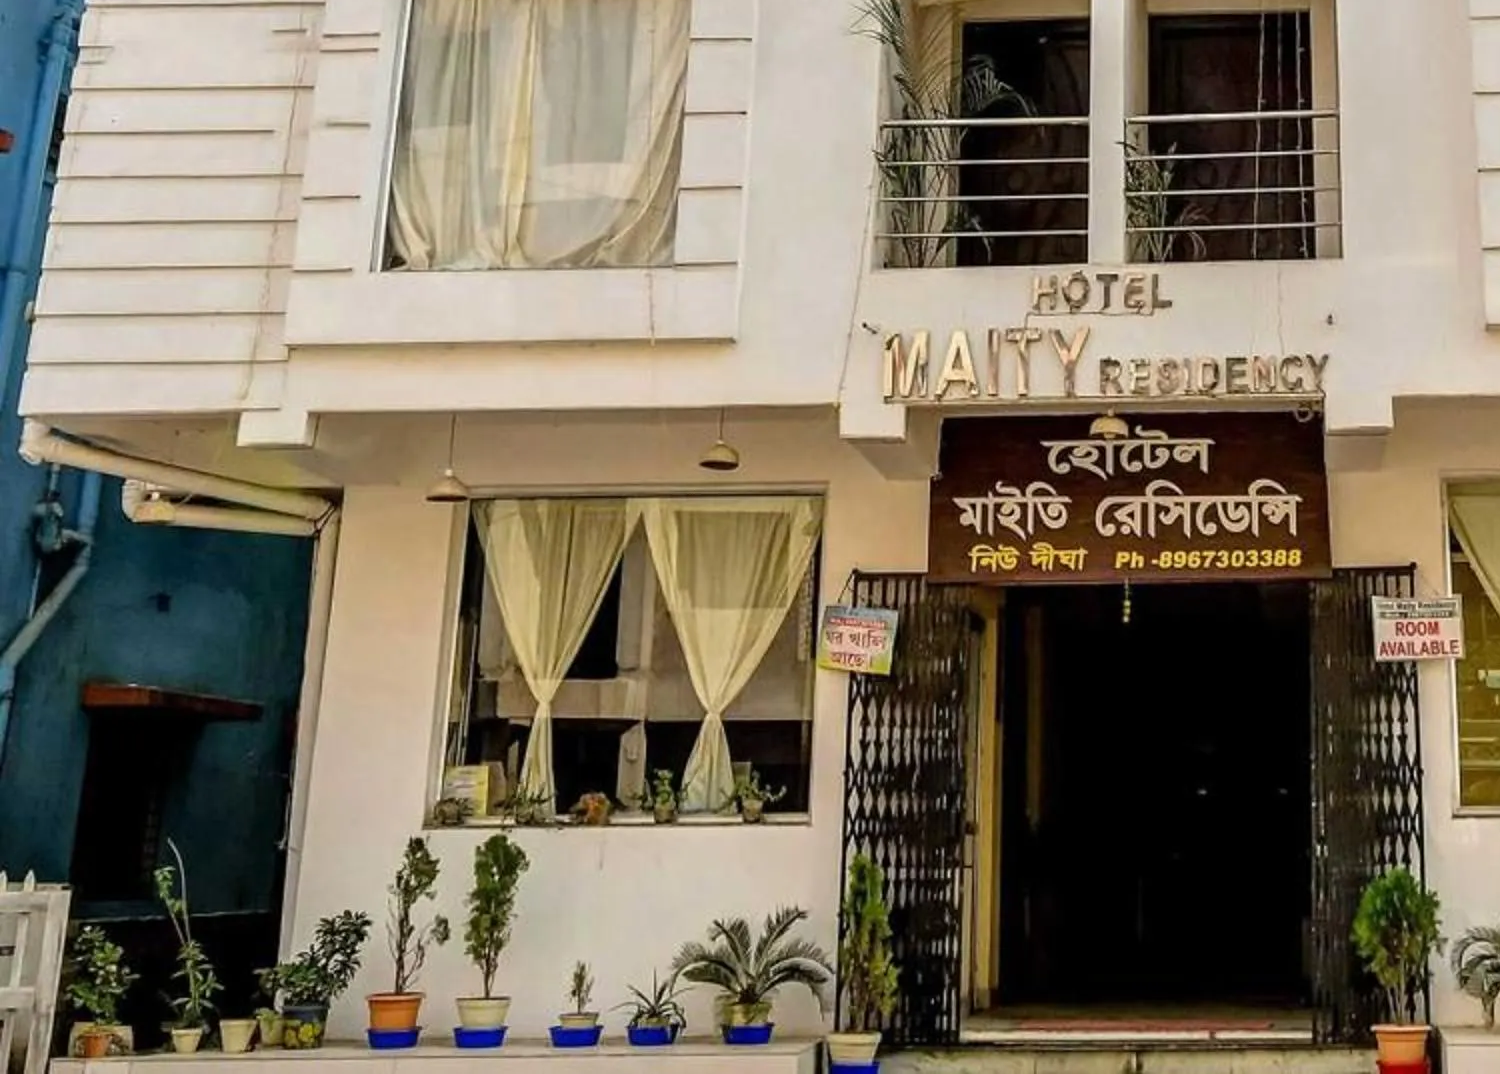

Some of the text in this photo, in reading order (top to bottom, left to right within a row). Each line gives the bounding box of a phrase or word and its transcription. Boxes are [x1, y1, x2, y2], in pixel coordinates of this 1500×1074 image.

[1031, 271, 1173, 312] HOTEL
[883, 327, 1329, 399] MAITY RESIDENCY
[1040, 426, 1214, 480] হোটেল
[953, 479, 1303, 541] মাইতি রেসিডেন্সি
[968, 545, 1020, 574] নিউ
[1028, 542, 1089, 571] দীঘা
[1115, 551, 1145, 569] Ph
[1380, 639, 1460, 657] AVAILABLE
[1395, 621, 1440, 637] ROOM
